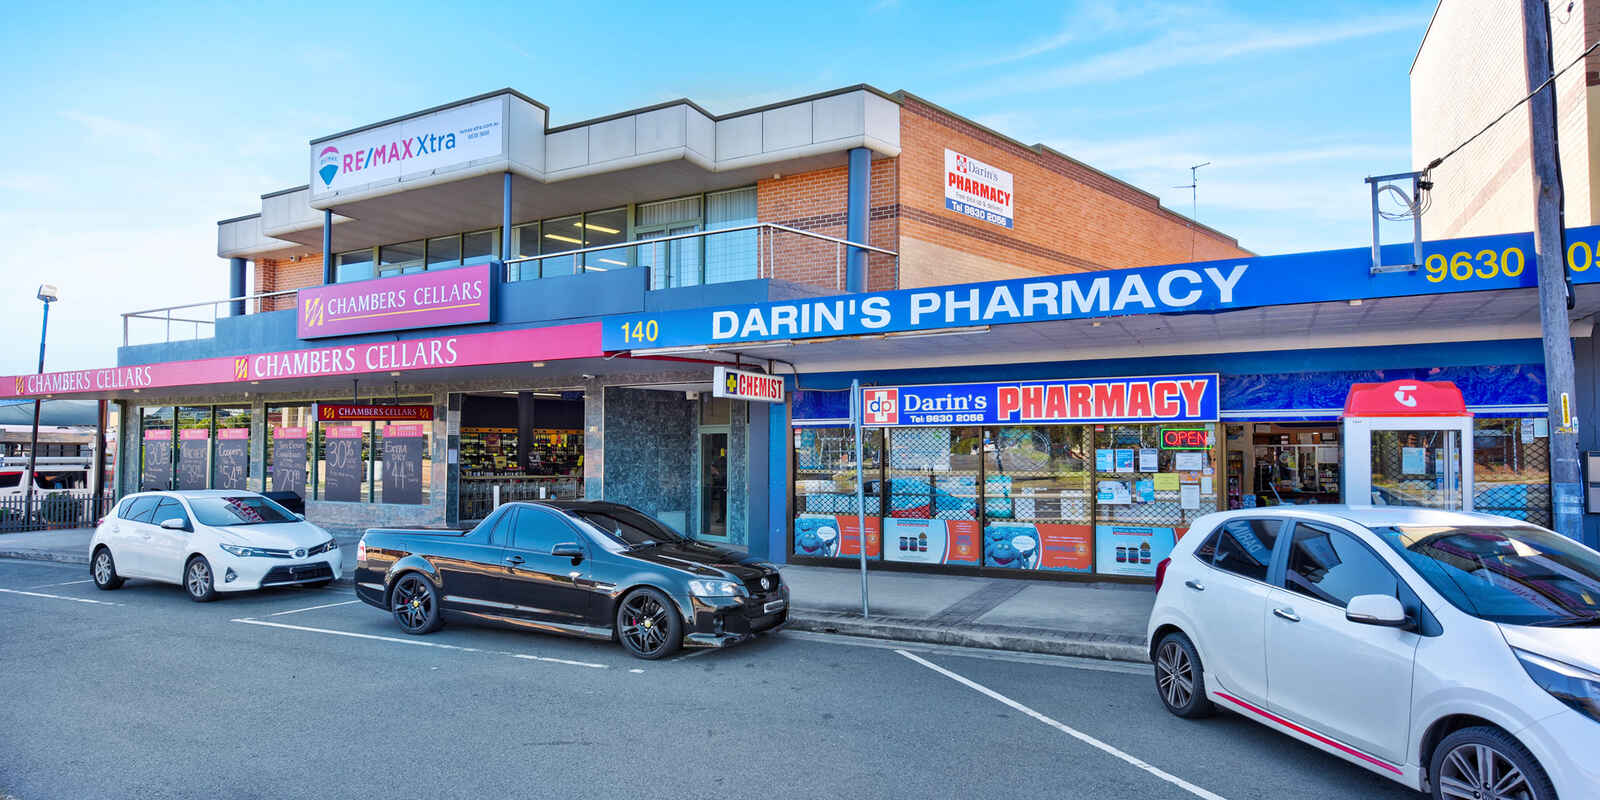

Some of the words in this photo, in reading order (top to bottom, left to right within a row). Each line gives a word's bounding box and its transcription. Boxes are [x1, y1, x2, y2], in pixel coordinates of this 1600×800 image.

[343, 137, 413, 174] RE/MAX
[416, 132, 456, 157] Xtra
[948, 171, 1011, 207] PHARMACY
[1424, 247, 1525, 283] 9630
[327, 289, 406, 316] CHAMBERS
[413, 280, 482, 306] CELLARS
[712, 296, 892, 340] DARIN'S
[909, 264, 1249, 325] PHARMACY
[620, 319, 659, 343] 140
[254, 347, 356, 378] CHAMBERS
[366, 338, 457, 370] CELLARS
[28, 371, 91, 393] CHAMBERS
[96, 366, 152, 389] CELLARS
[739, 374, 783, 400] CHEMIST
[338, 407, 384, 417] CHAMBERS
[385, 407, 417, 416] CELLARS
[903, 393, 987, 412] Darin's
[997, 380, 1209, 421] PHARMACY
[1165, 430, 1208, 446] OPEN
